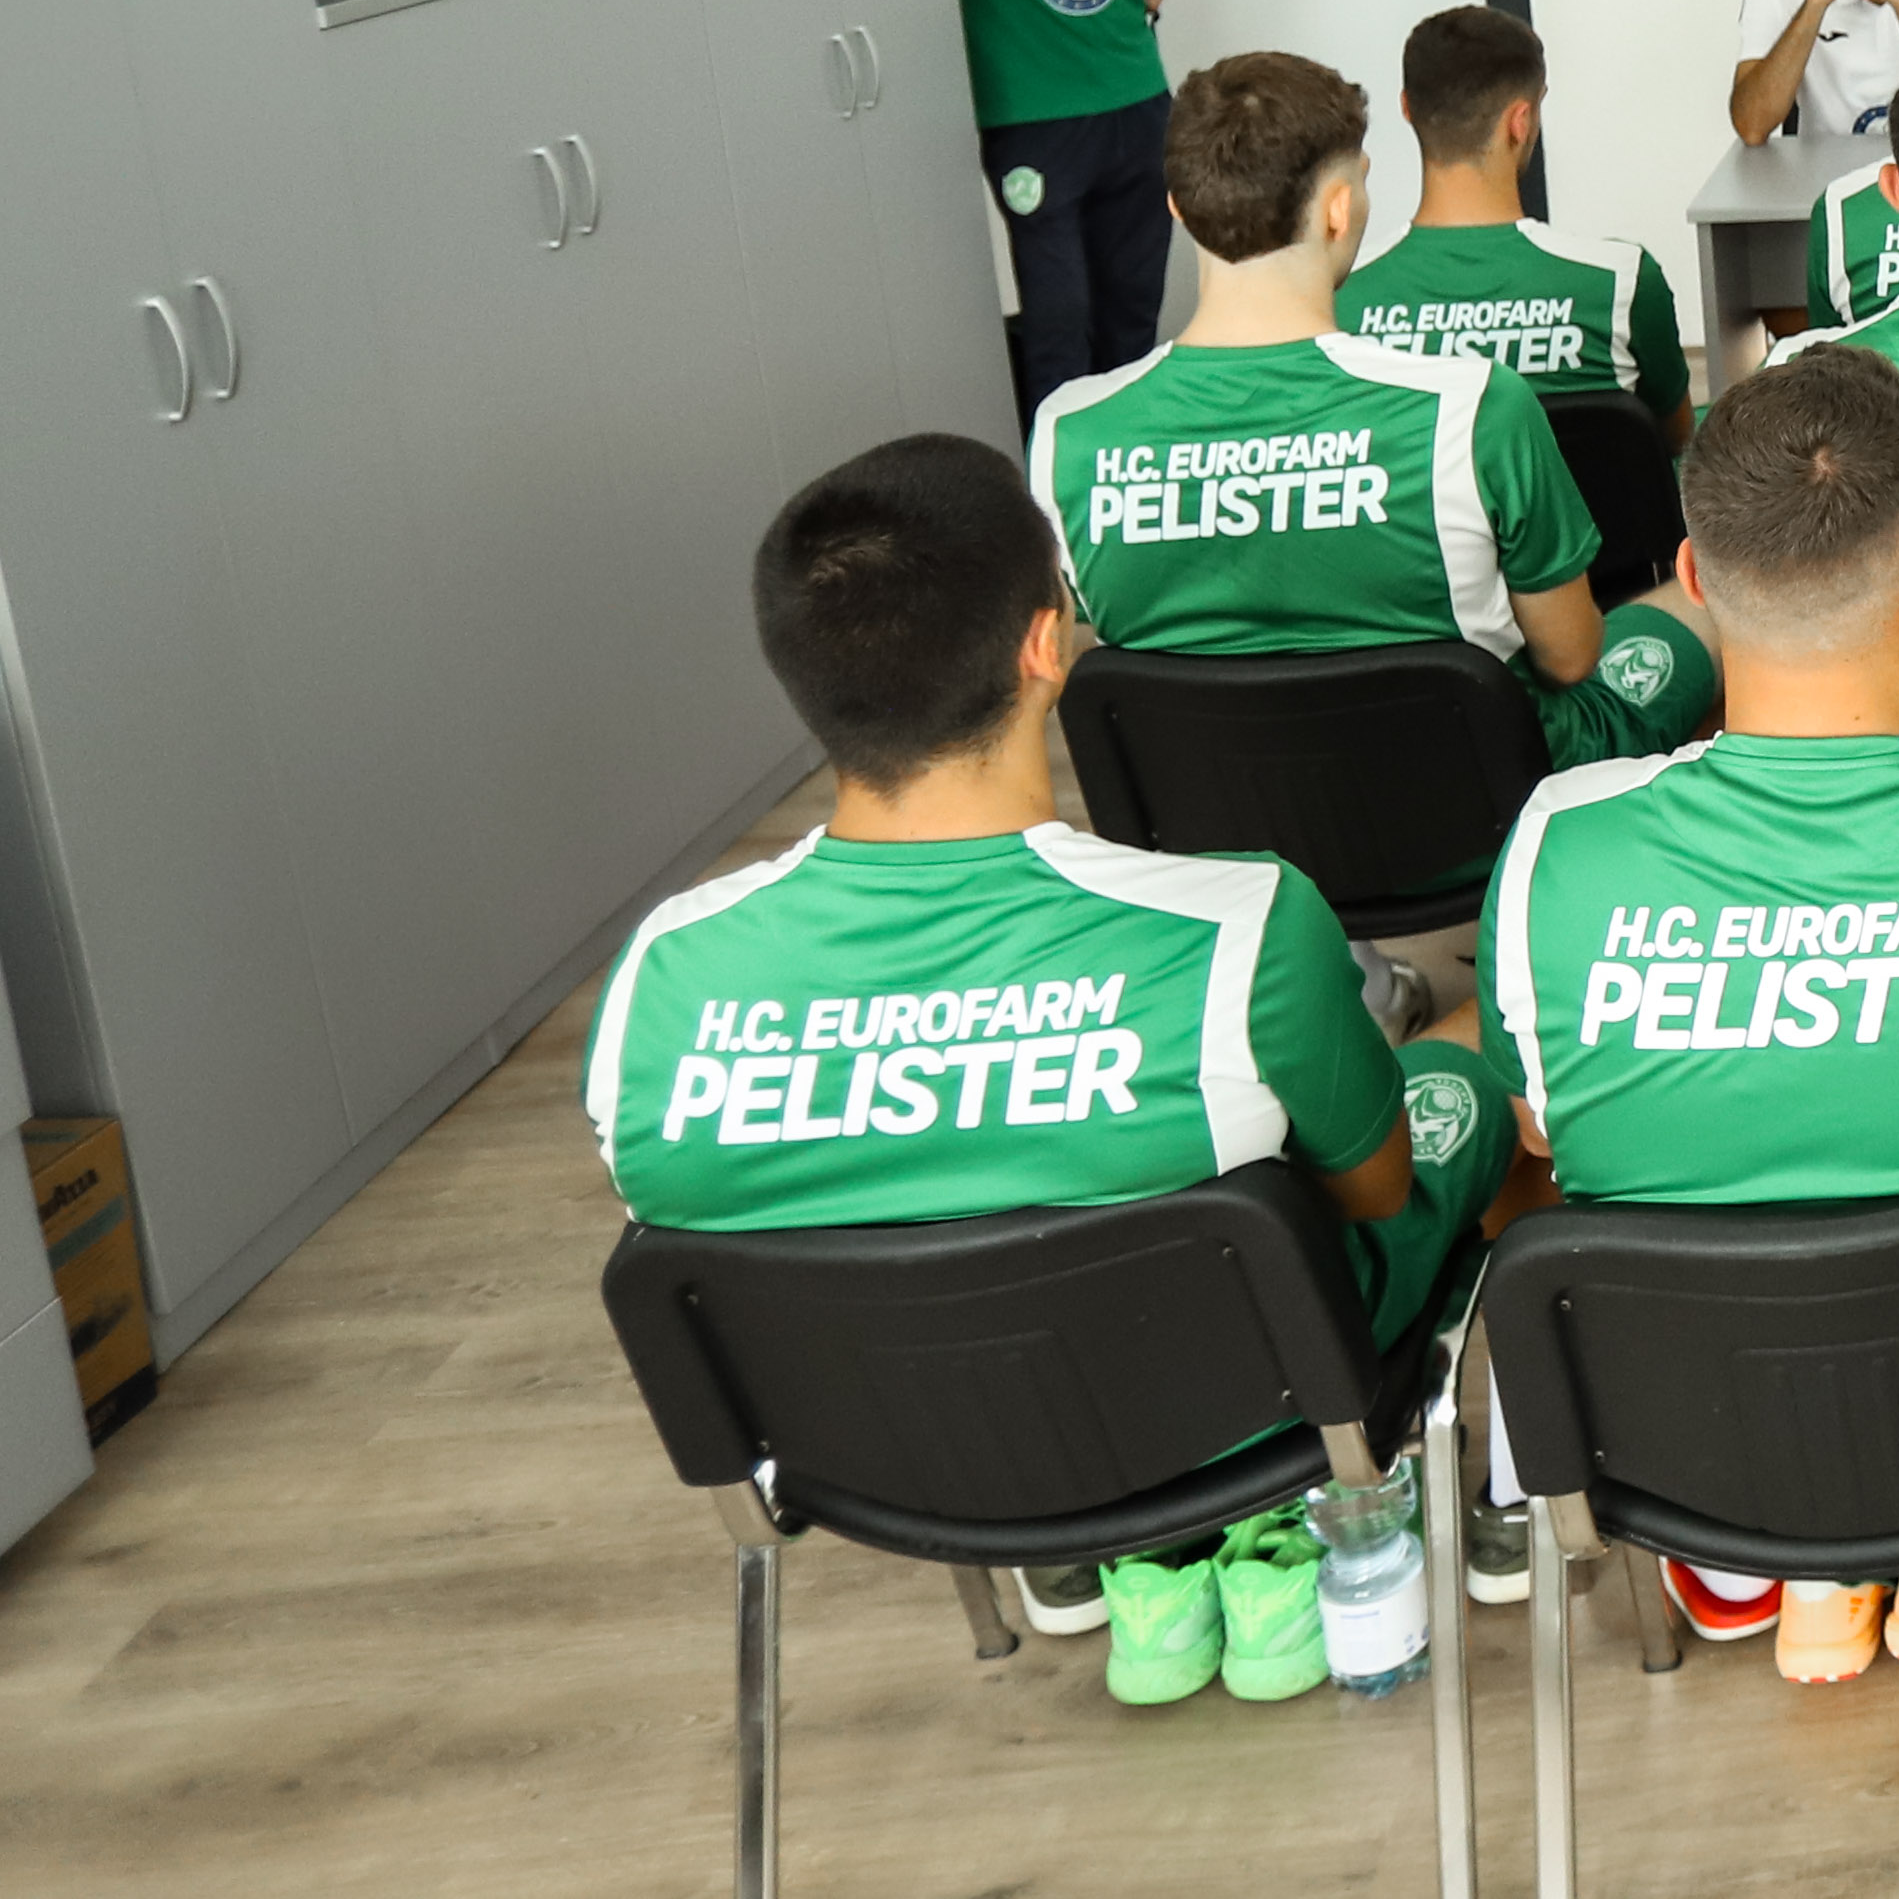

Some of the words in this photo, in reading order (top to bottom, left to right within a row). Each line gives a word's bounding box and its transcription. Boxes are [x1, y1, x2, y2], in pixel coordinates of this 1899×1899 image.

[1359, 304, 1413, 334] H.C.
[1416, 297, 1573, 332] EUROFARM
[1360, 325, 1585, 375] ISTER
[1095, 443, 1164, 485] H.C.
[1165, 428, 1371, 476] EUROFARM
[1087, 463, 1388, 546] PELISTER
[1603, 905, 1705, 958] H.C.
[693, 999, 793, 1053] H.C.
[801, 972, 1127, 1051] EUROFARM
[661, 1027, 1144, 1147] PELISTER
